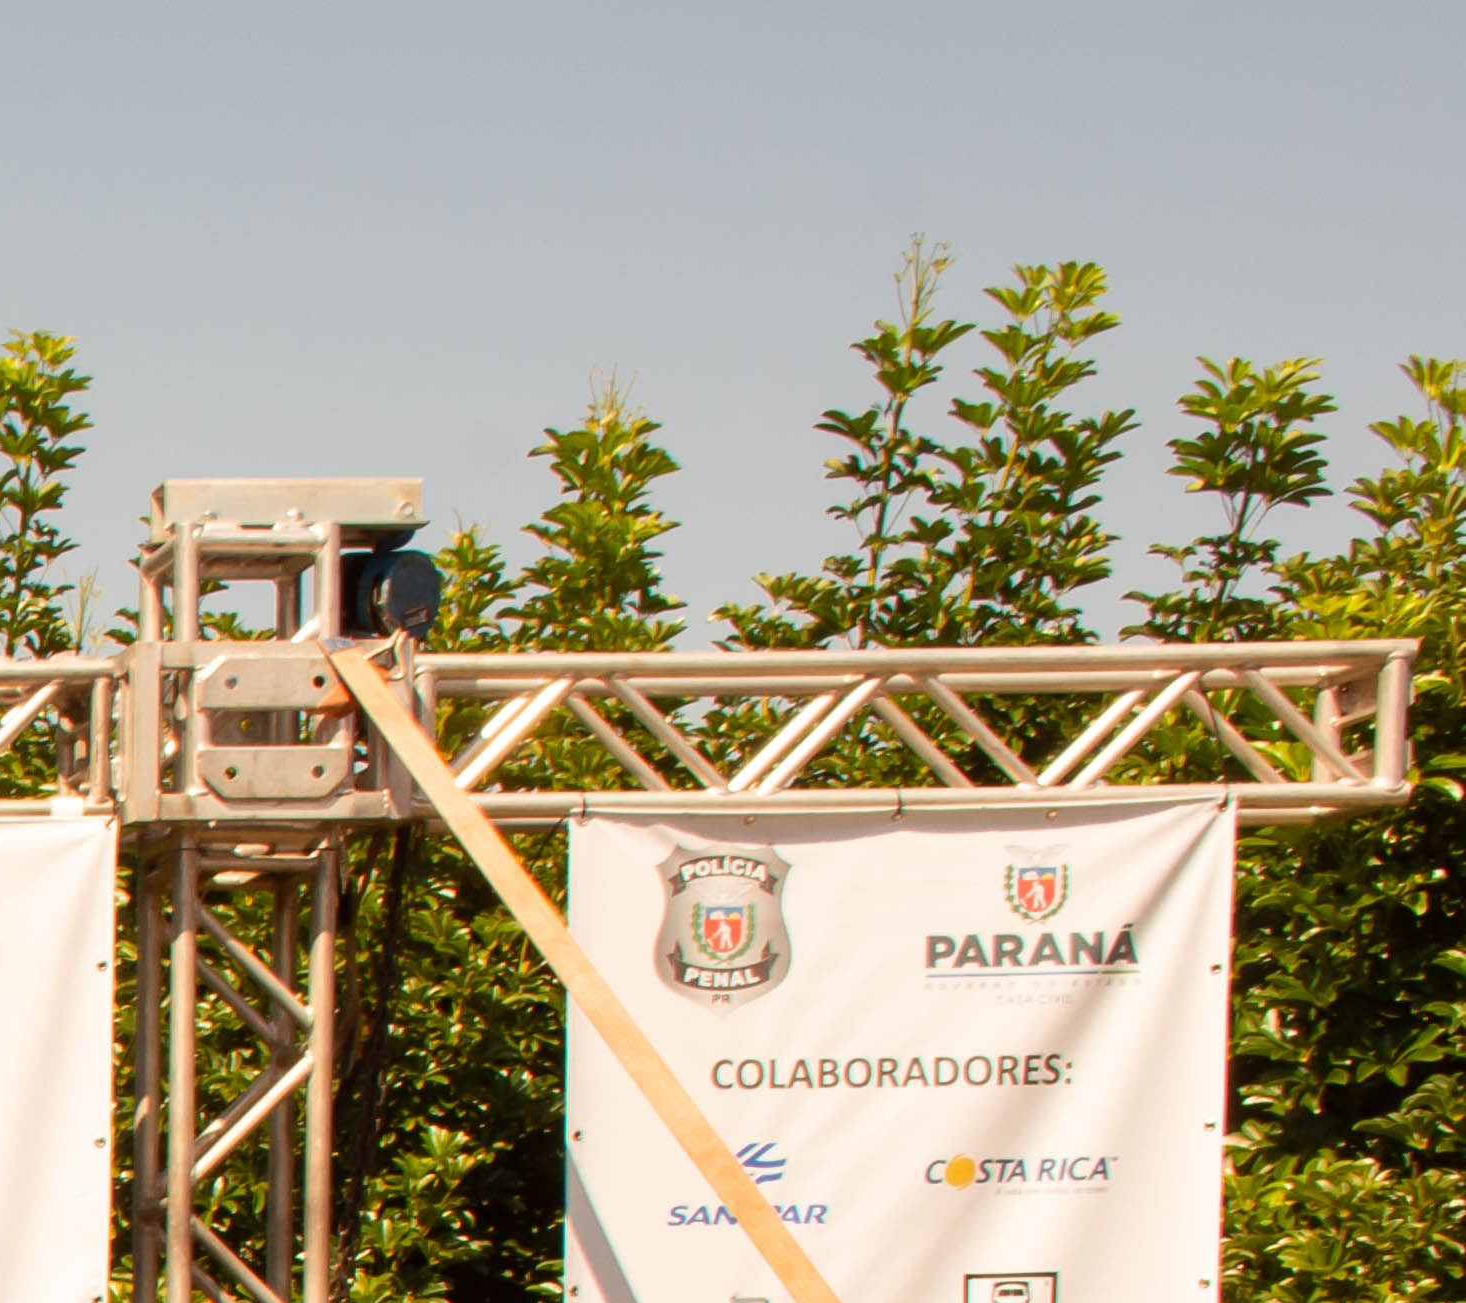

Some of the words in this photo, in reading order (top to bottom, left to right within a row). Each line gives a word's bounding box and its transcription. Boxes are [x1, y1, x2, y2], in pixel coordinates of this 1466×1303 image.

[680, 856, 768, 882] POLÍCIA
[925, 923, 1140, 969] PARANÁ
[683, 967, 761, 988] PENAL
[711, 1053, 1074, 1091] COLABORADORES:
[1036, 1156, 1112, 1182] RICA
